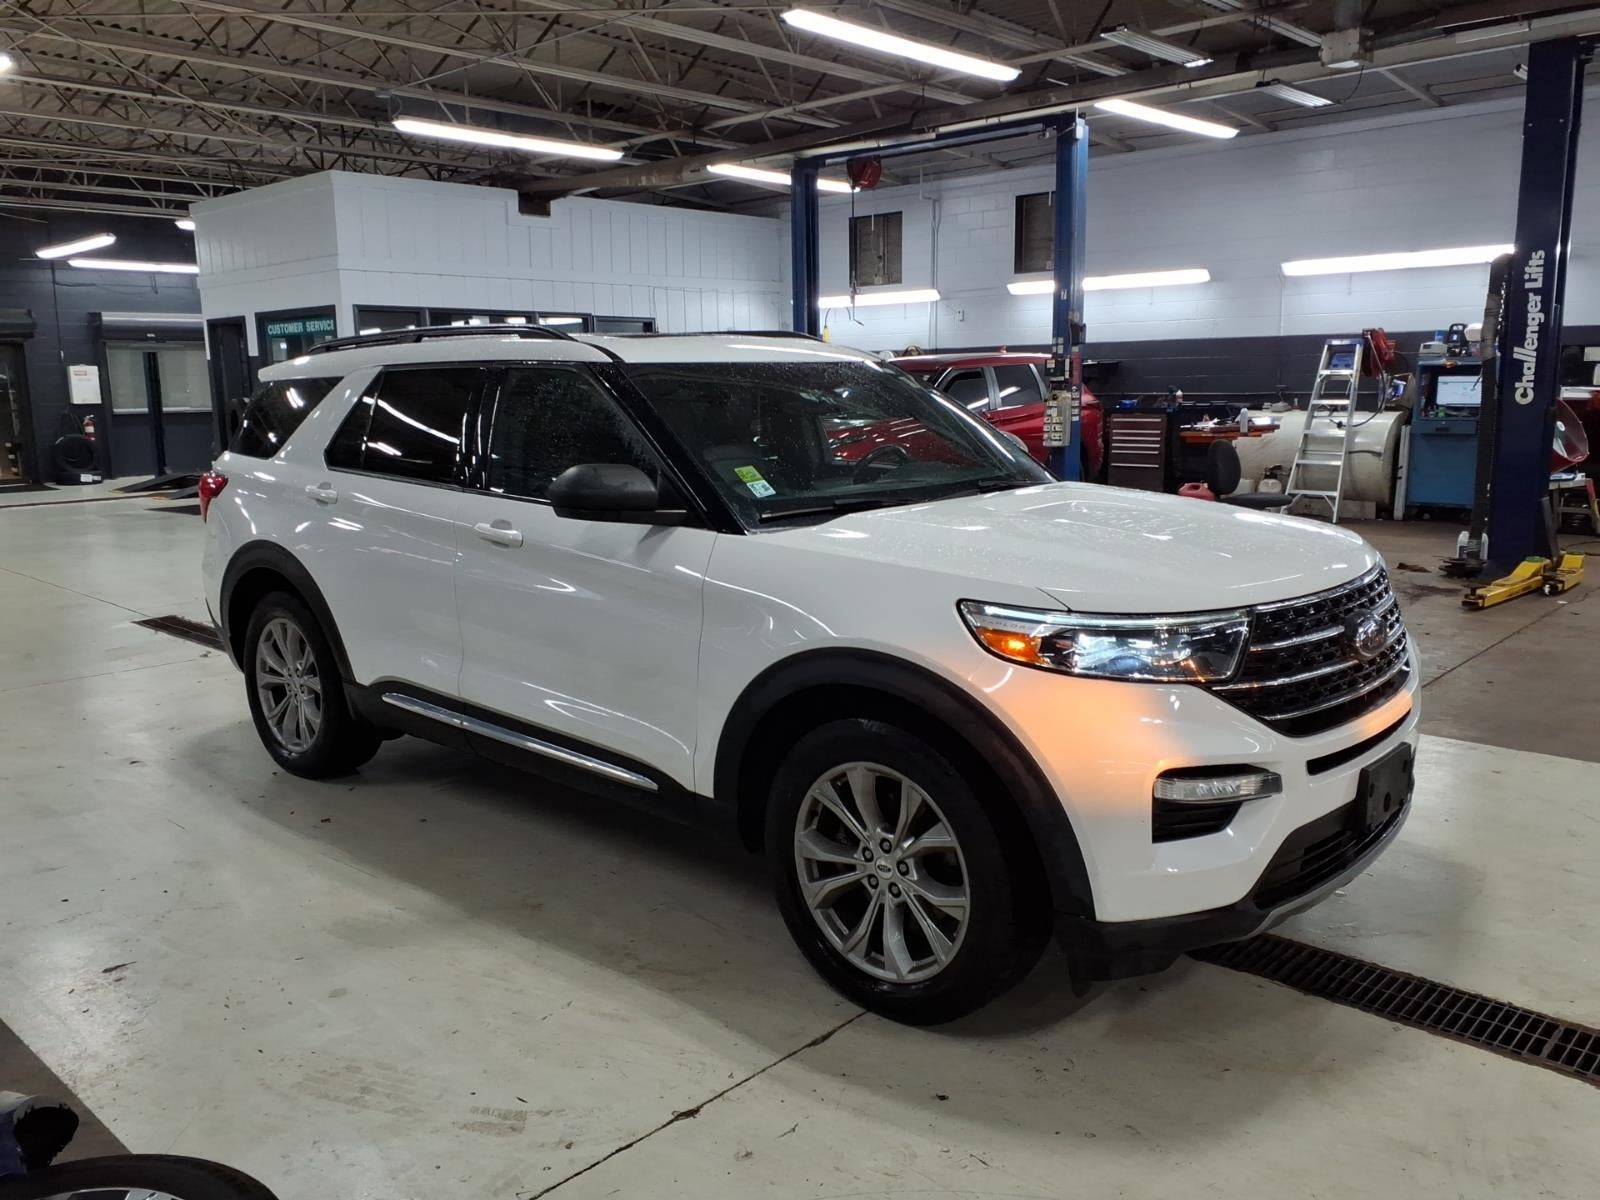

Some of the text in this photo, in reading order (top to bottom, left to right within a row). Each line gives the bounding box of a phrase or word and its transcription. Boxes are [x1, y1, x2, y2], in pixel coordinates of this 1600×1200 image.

[267, 322, 304, 335] CUSTOMER
[1513, 249, 1546, 405] Challenger Lifts
